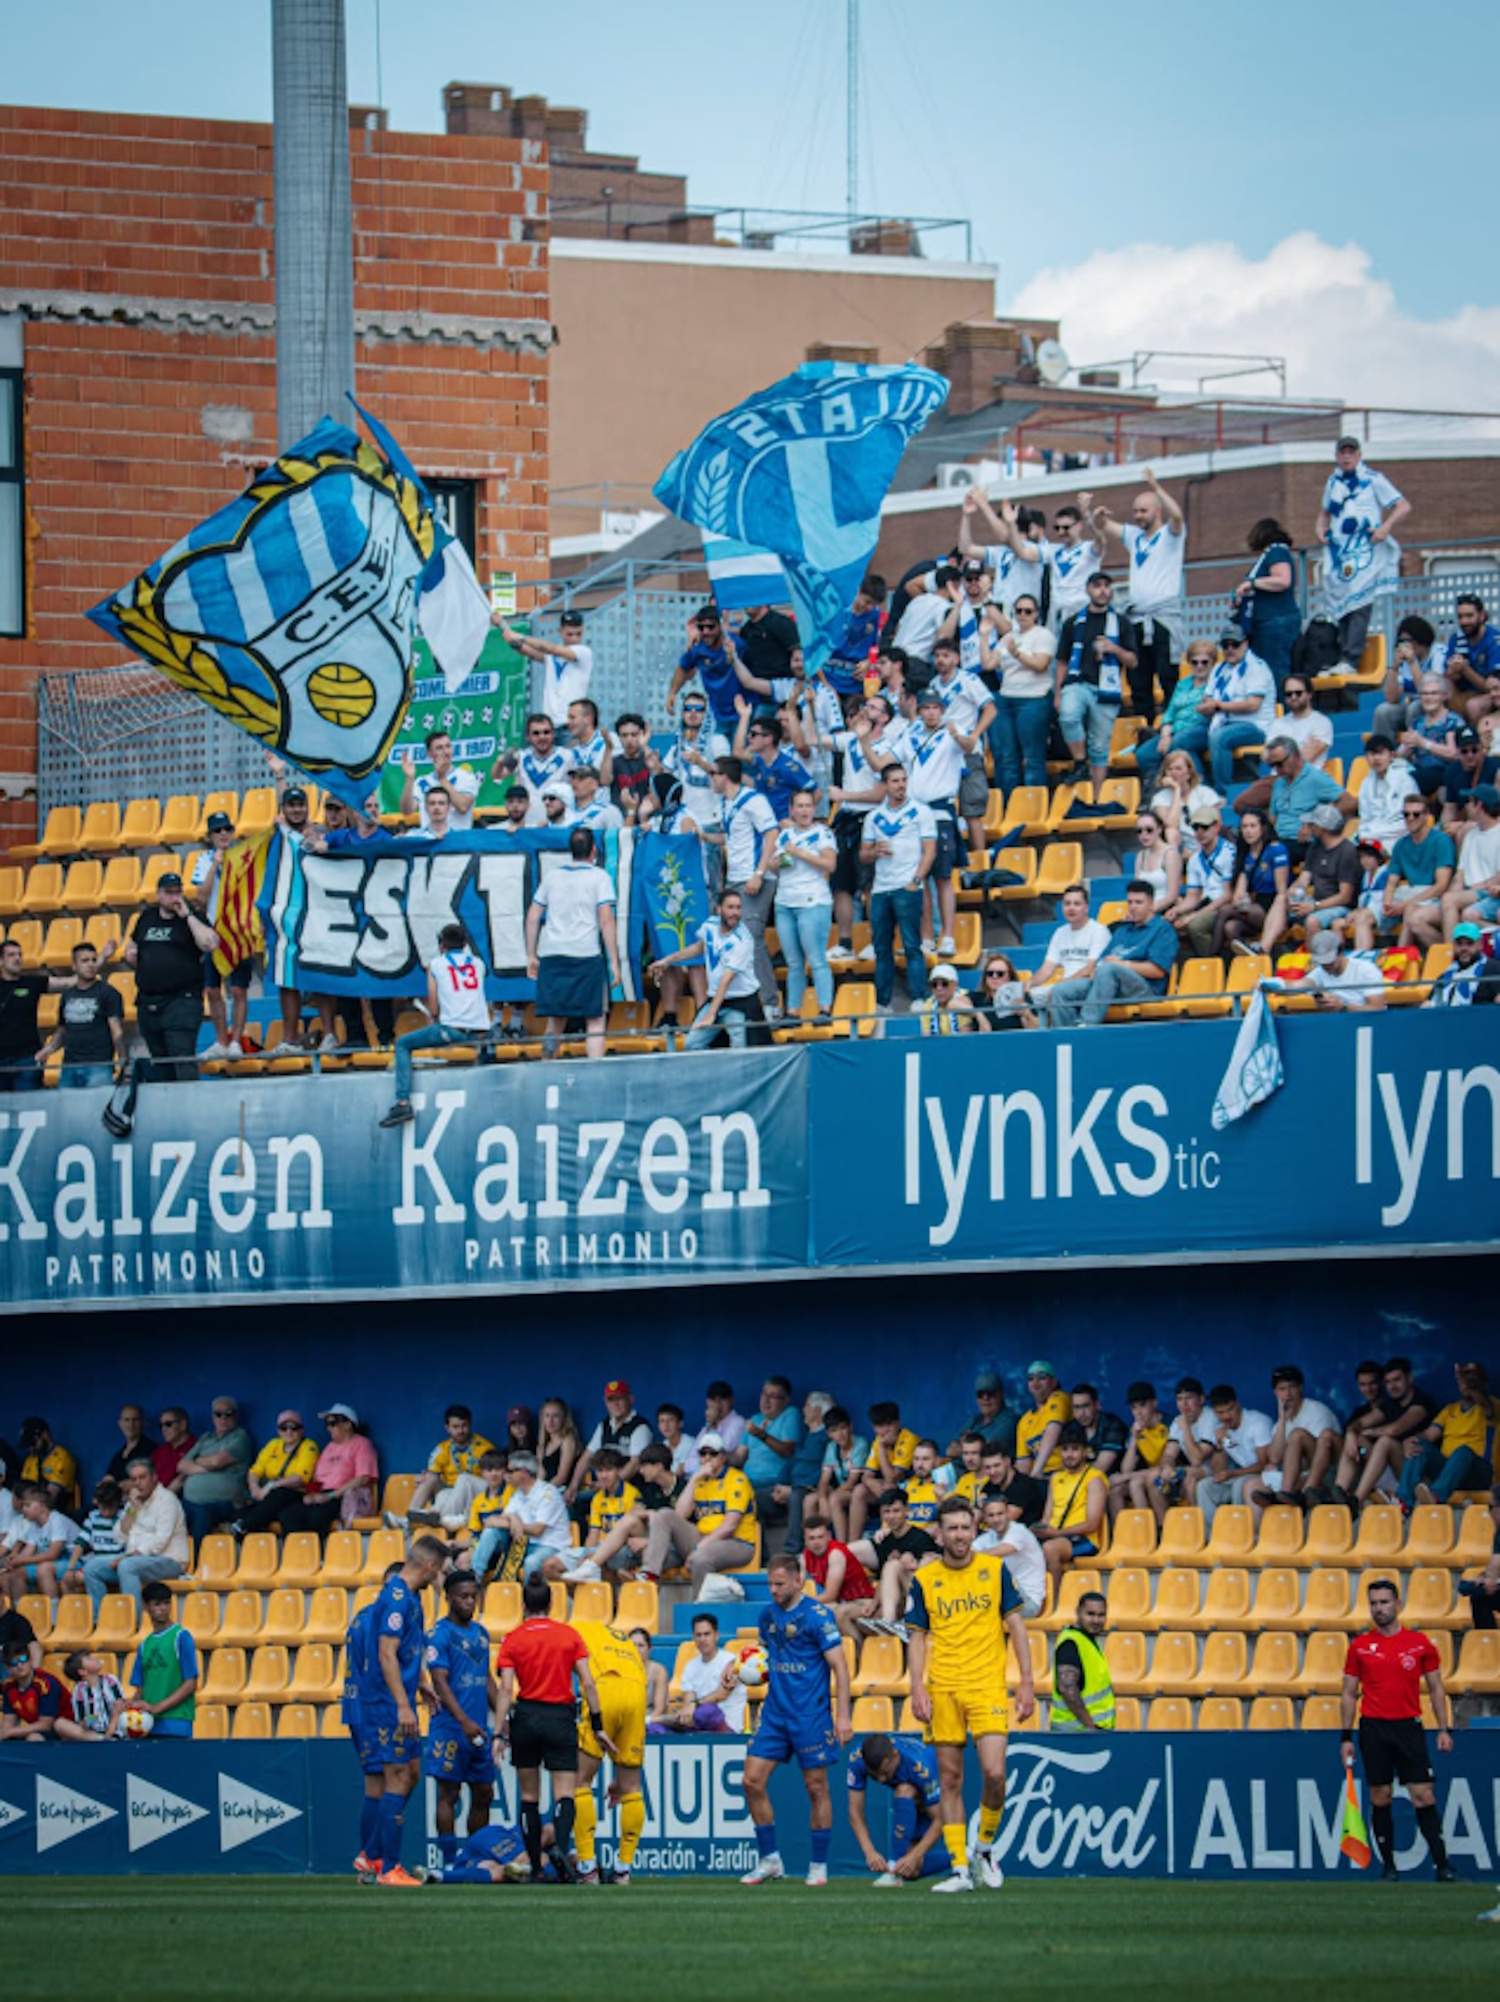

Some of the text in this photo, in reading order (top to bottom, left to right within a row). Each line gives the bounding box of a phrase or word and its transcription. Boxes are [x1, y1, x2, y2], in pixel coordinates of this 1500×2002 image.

[300, 851, 573, 976] ESK1
[447, 964, 479, 991] 13
[393, 1085, 771, 1223] Kaizen
[0, 1110, 333, 1241] Kaizen
[46, 1247, 266, 1286] PATRIMONIO
[465, 1229, 698, 1270] PATRIMONIO
[936, 1592, 992, 1618] lynks
[445, 1740, 458, 1760] 8
[967, 1743, 1161, 1870] Ford
[707, 1842, 759, 1870] Jardín
